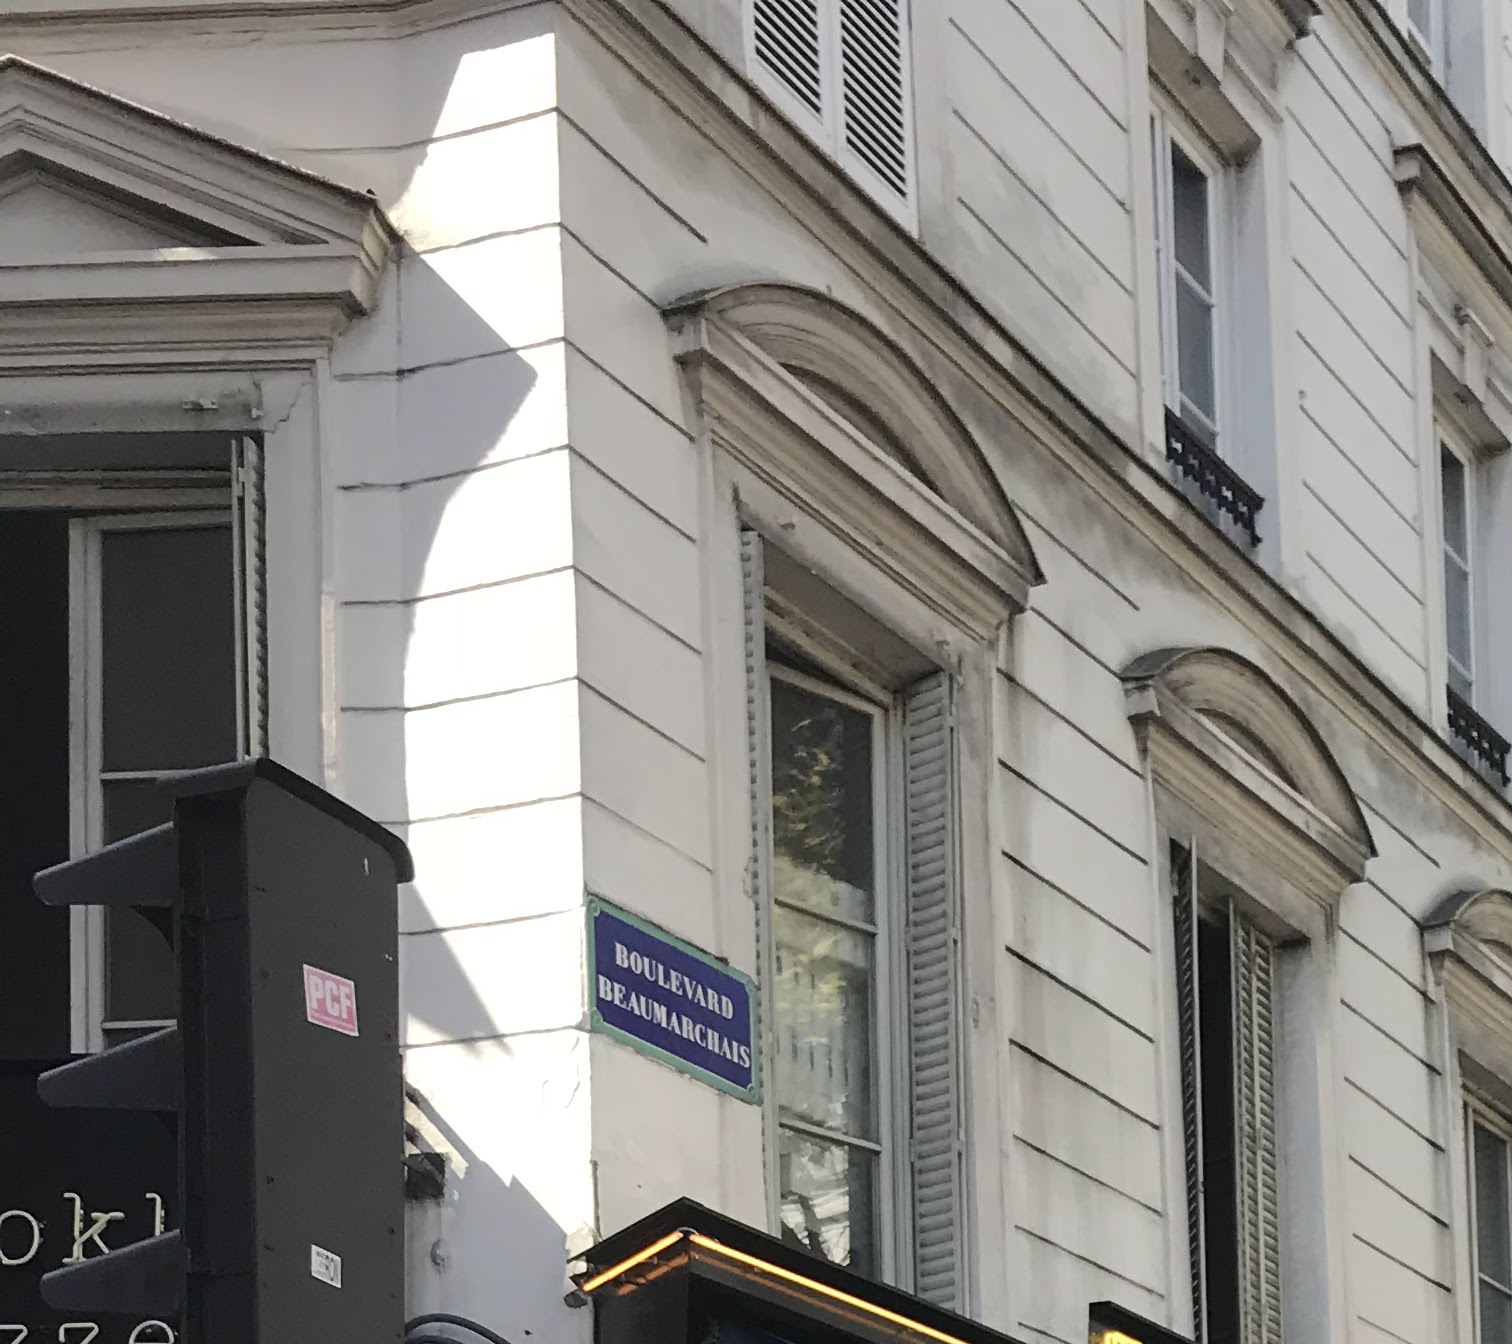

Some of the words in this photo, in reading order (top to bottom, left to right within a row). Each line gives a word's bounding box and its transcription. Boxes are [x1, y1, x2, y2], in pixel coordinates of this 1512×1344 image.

[309, 974, 351, 1020] PCF
[614, 941, 734, 1020] BOULEVARD
[598, 974, 751, 1068] BEAUMARCHAIS
